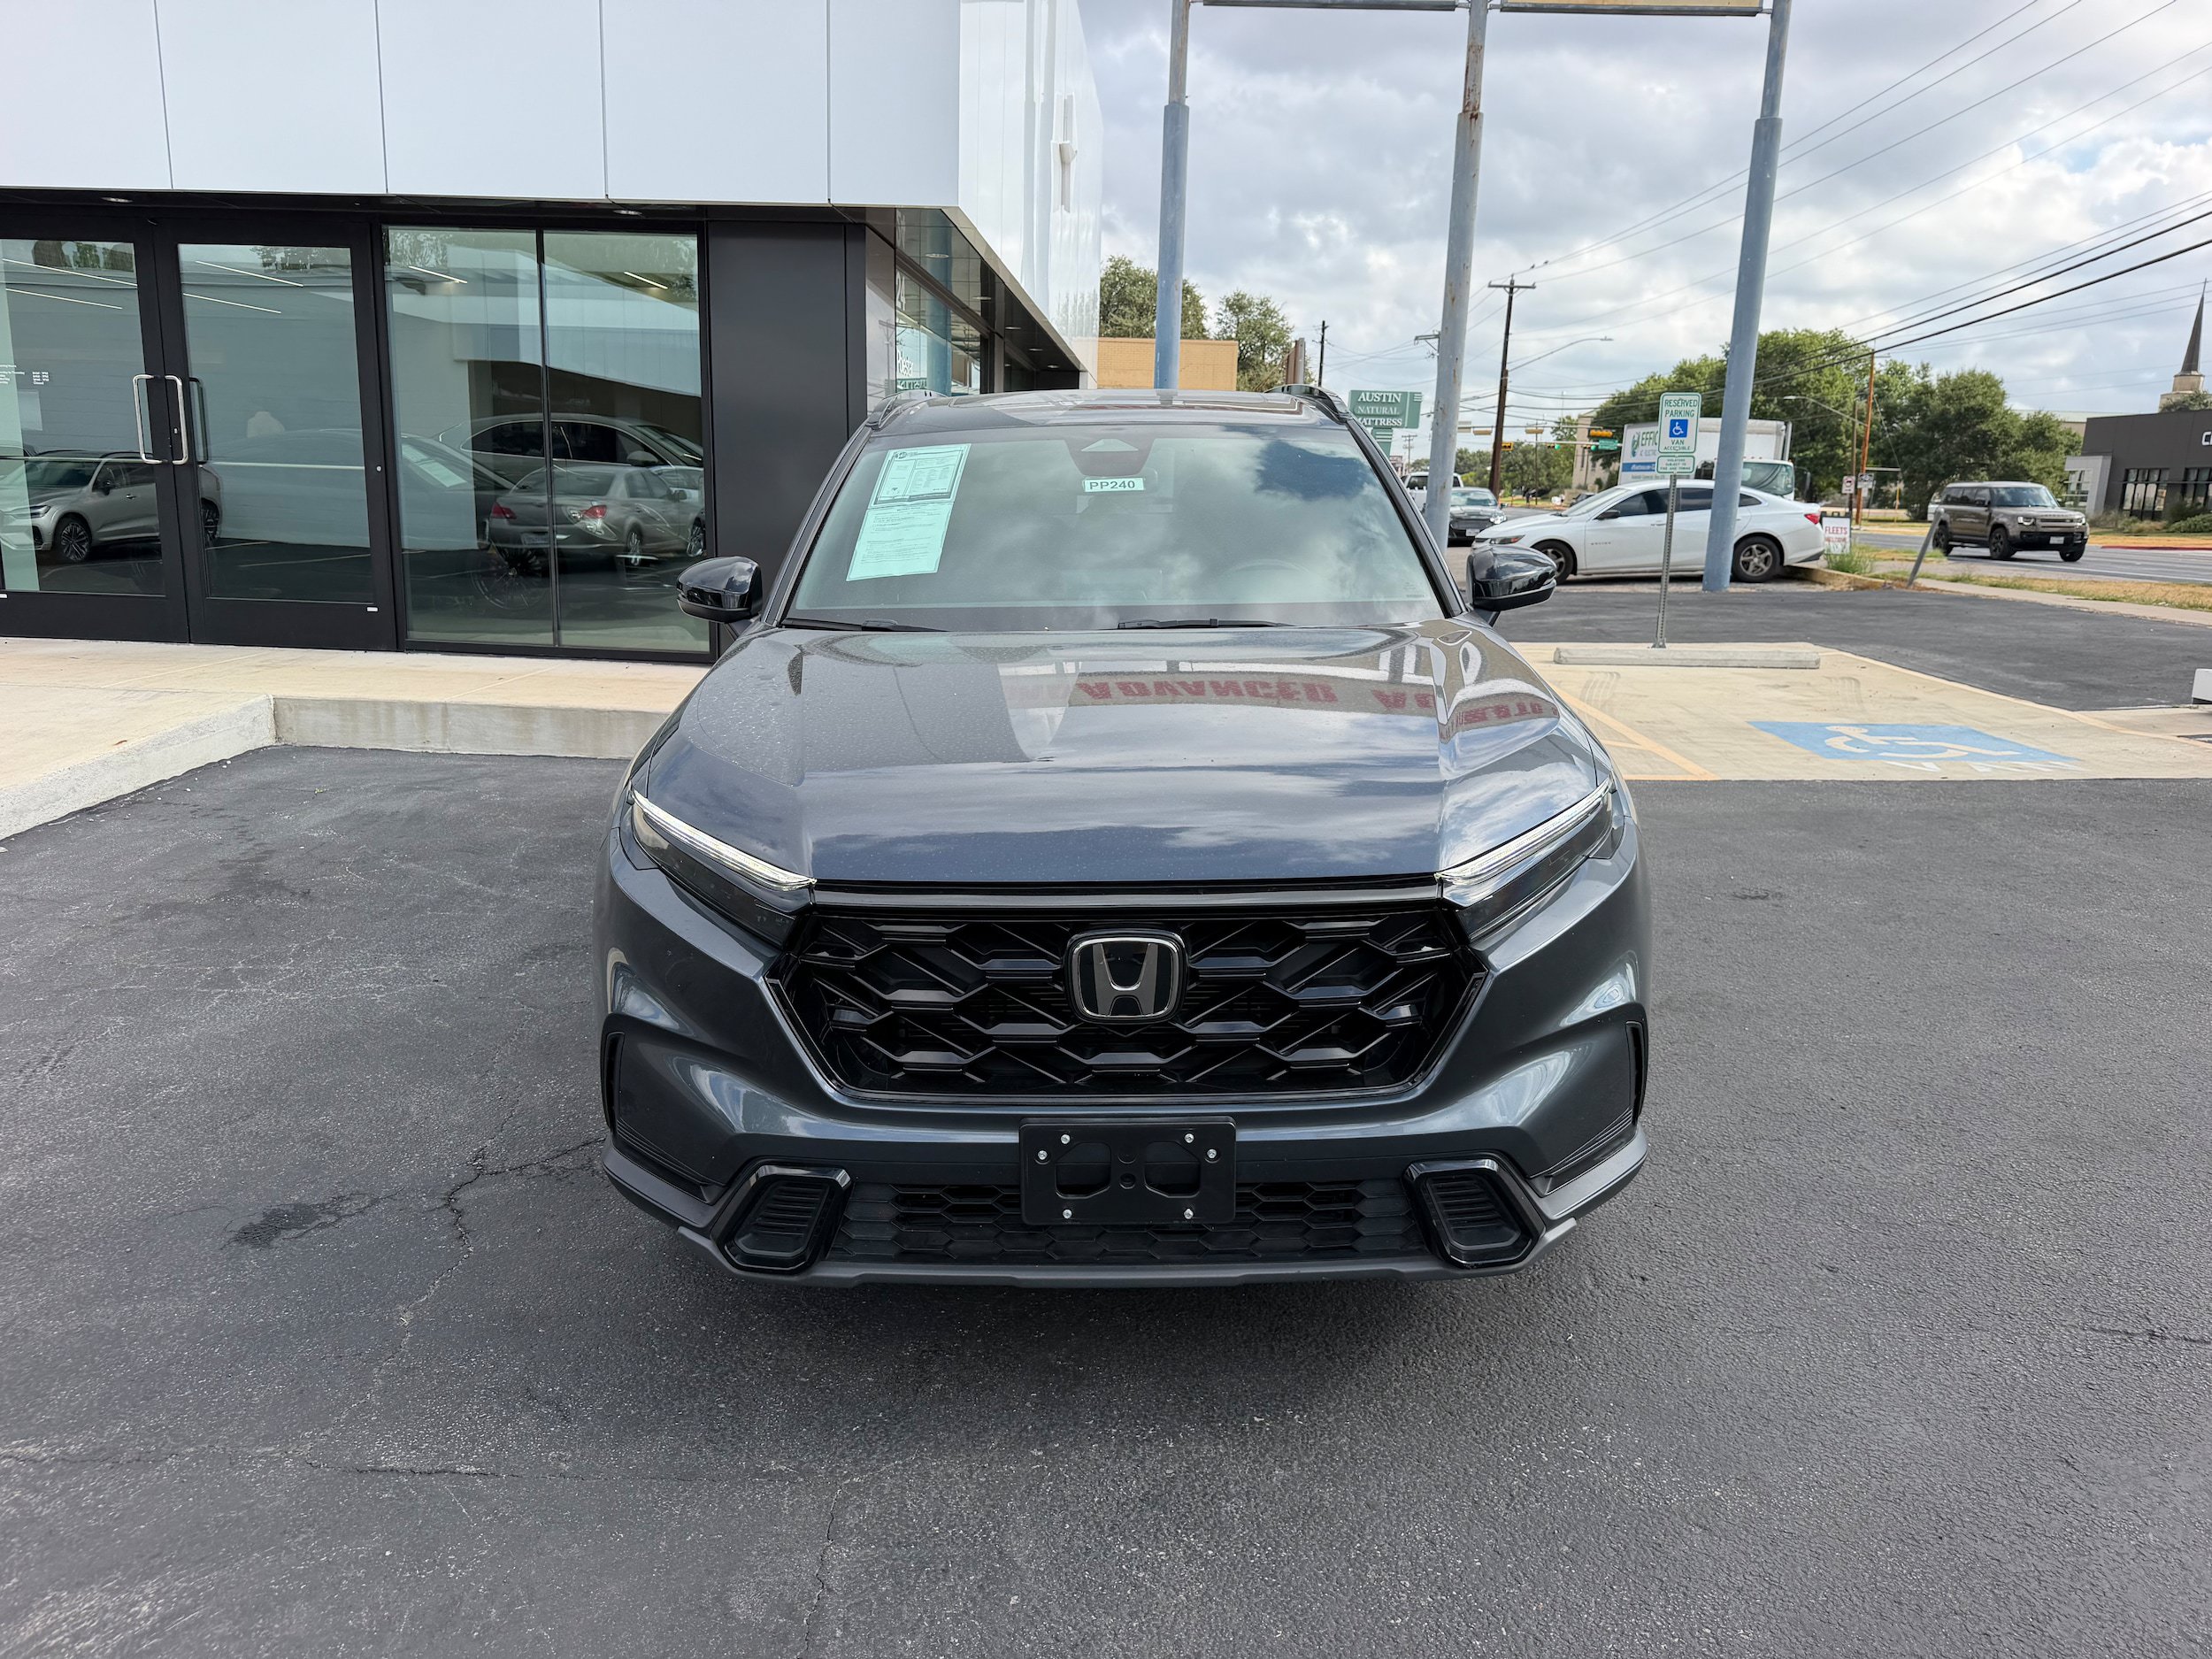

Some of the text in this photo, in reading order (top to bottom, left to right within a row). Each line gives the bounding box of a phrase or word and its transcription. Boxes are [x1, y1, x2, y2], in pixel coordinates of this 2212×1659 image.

[1357, 392, 1402, 403] AUSTIN
[1664, 398, 1698, 407] RESERVED
[1357, 406, 1400, 415] NATURAL
[1664, 409, 1694, 418] PARKING
[1089, 480, 1135, 490] PP240
[1824, 526, 1847, 534] FLEETS
